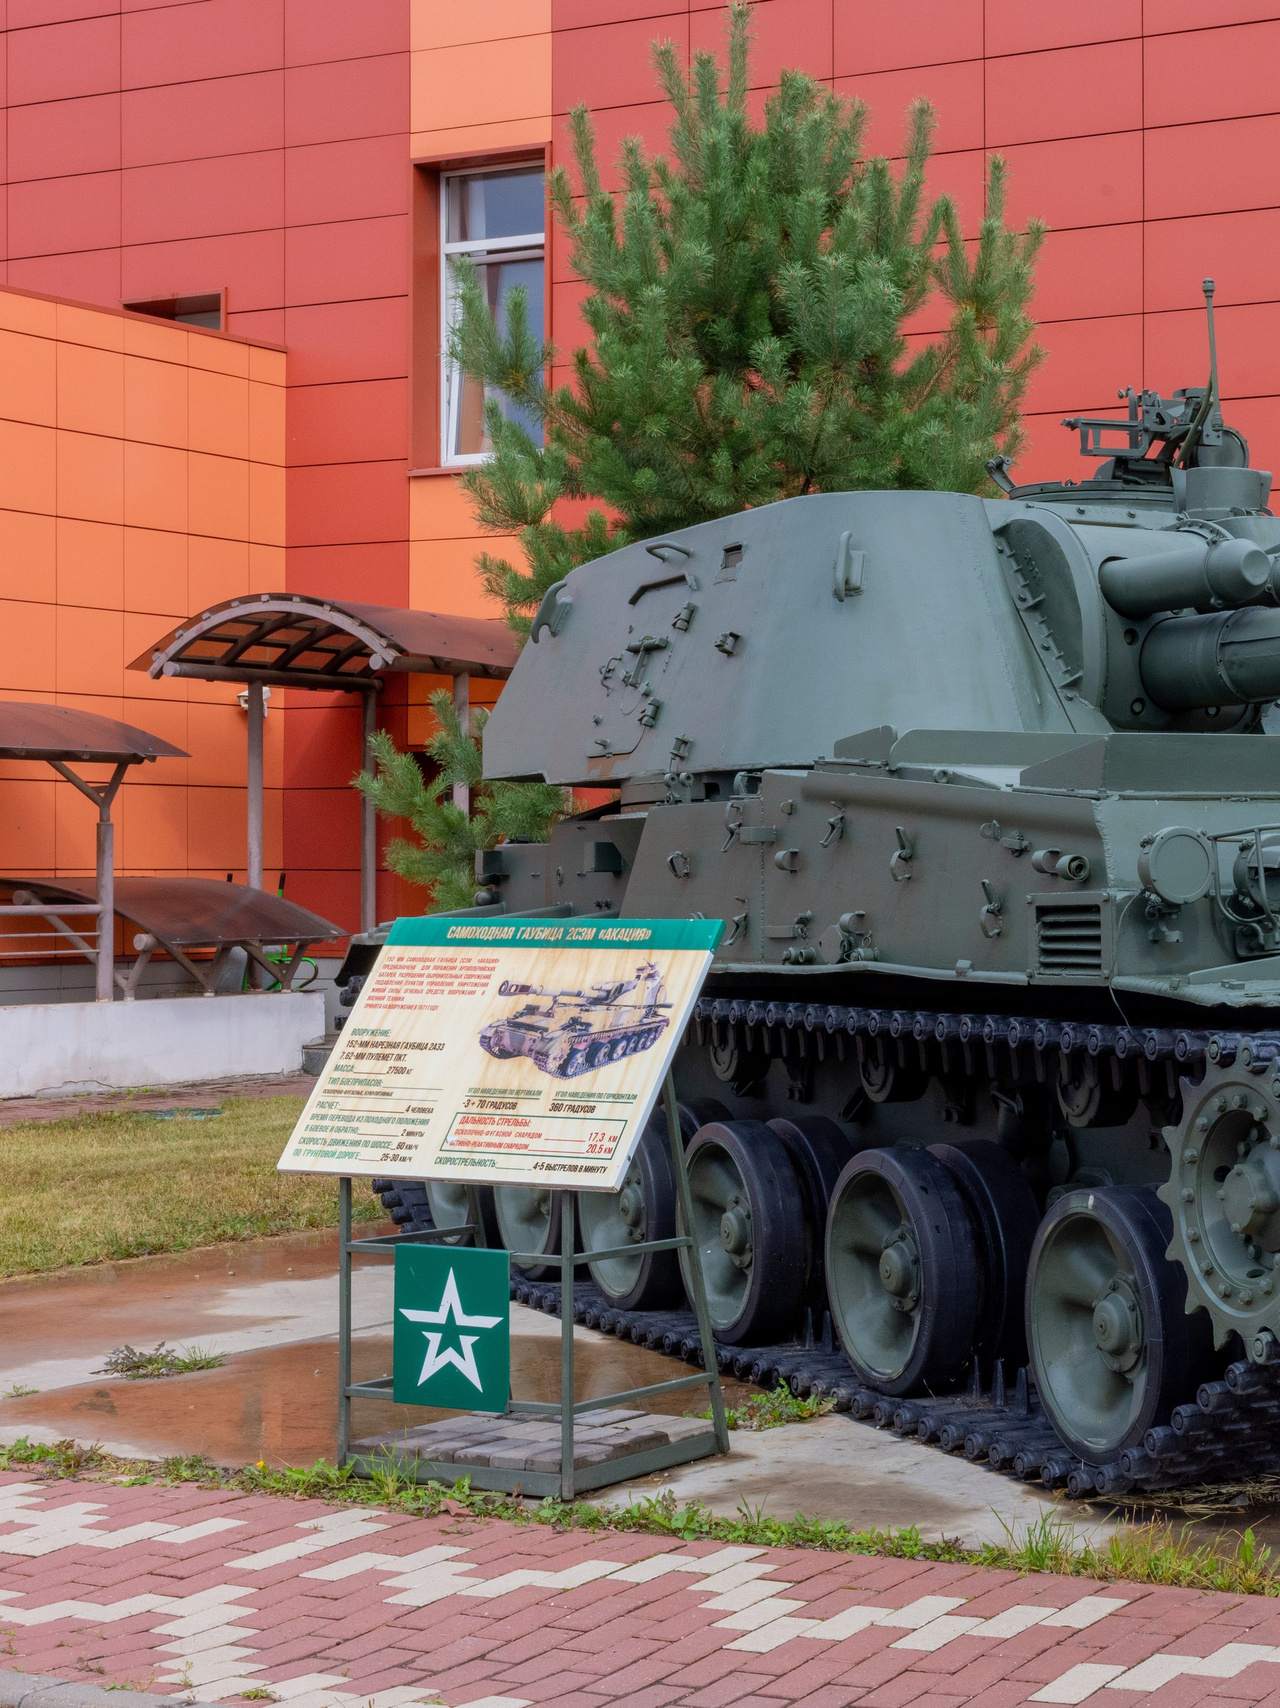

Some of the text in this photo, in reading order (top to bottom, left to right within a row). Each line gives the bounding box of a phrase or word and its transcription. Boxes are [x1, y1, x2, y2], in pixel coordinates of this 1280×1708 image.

[446, 926, 515, 940] САМОХОДНАЯ
[516, 927, 564, 942] ГАУБИЦА
[598, 928, 652, 942] «АКАЦИЯ»
[351, 1028, 392, 1037] ВООРУЖЕНИЕ:
[346, 1040, 370, 1049] 152-ММ
[369, 1041, 401, 1050] НАРЕЗНАЯ
[400, 1042, 428, 1051] ГАУБИЦА
[340, 1052, 408, 1062] 7,62-ММ ПУЛЕМЕТ ПКТ.
[386, 1066, 407, 1075] 27500
[328, 1077, 383, 1087] ТИП БОЕПРИПАСОВ:
[507, 1088, 516, 1096] ПО
[515, 1089, 543, 1097] ВЕРТИКАЛИ
[554, 1090, 638, 1101] УГОЛ НАВЕДЕНИЯ ПО ГОРИЗОНТАЛИ
[316, 1100, 340, 1109] РАСЧЕТ:
[405, 1105, 411, 1113] 4
[476, 1099, 487, 1109] 70
[486, 1100, 518, 1111] ГРАДУСОВ
[549, 1102, 596, 1114] 360 ГРАДУСОВ
[310, 1113, 329, 1121] ВРЕМЯ
[329, 1114, 356, 1122] ПЕРЕВОДА
[364, 1115, 396, 1124] ПОХОДНОГО
[395, 1117, 430, 1126] ПОЛОЖЕНИЯ
[458, 1115, 532, 1127] ДАЛЬНОСТЬ СТРЕЛЬБЫ:
[309, 1124, 330, 1132] БОЕВОЕ
[400, 1128, 407, 1136] 2
[454, 1127, 513, 1138] ОСКОЛОЧНО-ФУГАСНОЙ
[514, 1131, 543, 1139] СНАРЯДОМ
[588, 1132, 606, 1143] 17,3
[298, 1136, 328, 1146] СКОРОСТЬ
[327, 1138, 362, 1147] ДВИЖЕНИЯ
[361, 1139, 371, 1148] ПО
[396, 1141, 406, 1150] 60
[586, 1143, 605, 1154] 20,5
[292, 1148, 303, 1156] ПО
[303, 1149, 338, 1158] ГРУНТОВОЙ
[380, 1153, 400, 1162] 25-30
[434, 1156, 609, 1174] СКОРОСТРЕЛЬНОСТЬ: 4-5 ВЫСТРЕЛОВ В МИНУТУ
